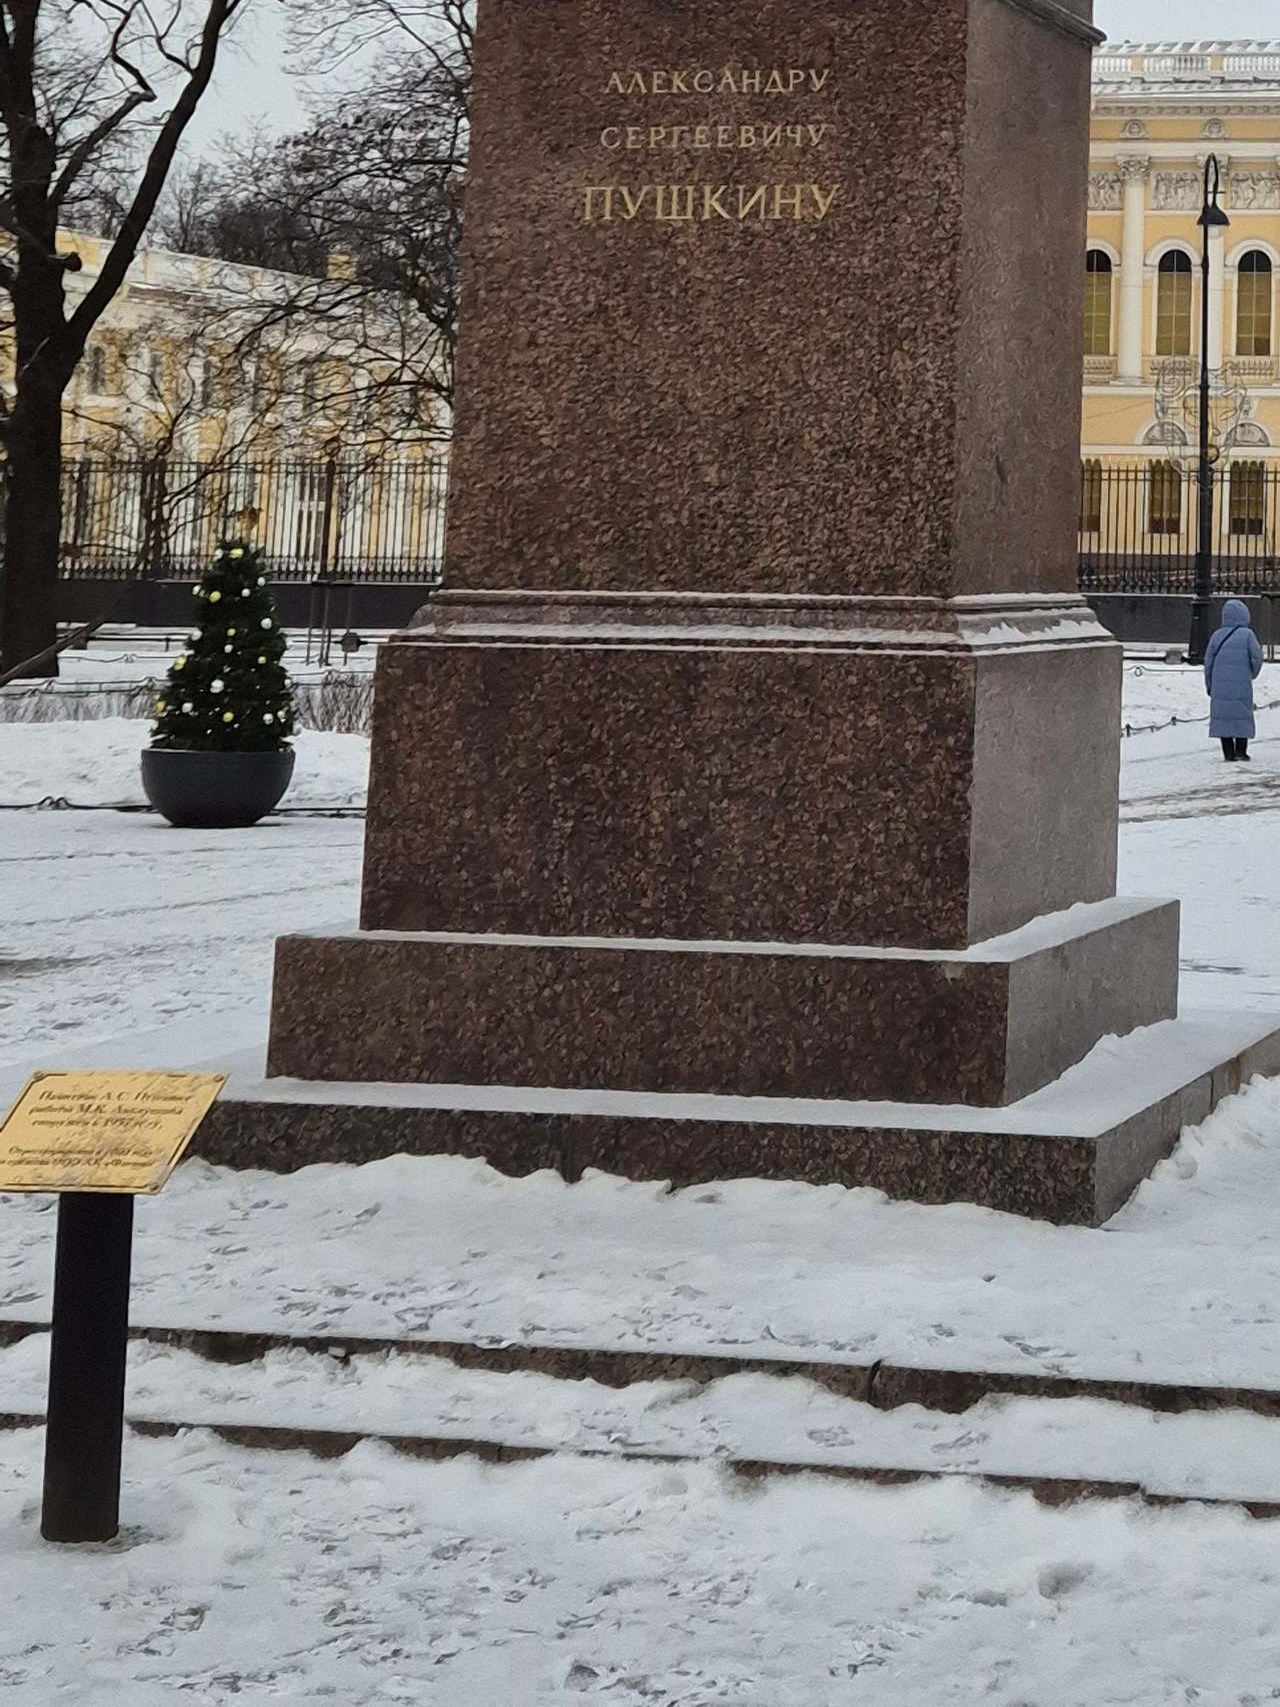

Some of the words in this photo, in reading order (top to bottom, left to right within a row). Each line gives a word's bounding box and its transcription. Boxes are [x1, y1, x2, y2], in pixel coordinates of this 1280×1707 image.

[604, 68, 831, 94] АЛЕКСАНДРУ
[600, 124, 832, 149] СЕРГЕЕВИЧУ
[583, 184, 840, 220] ПУШКИНУ
